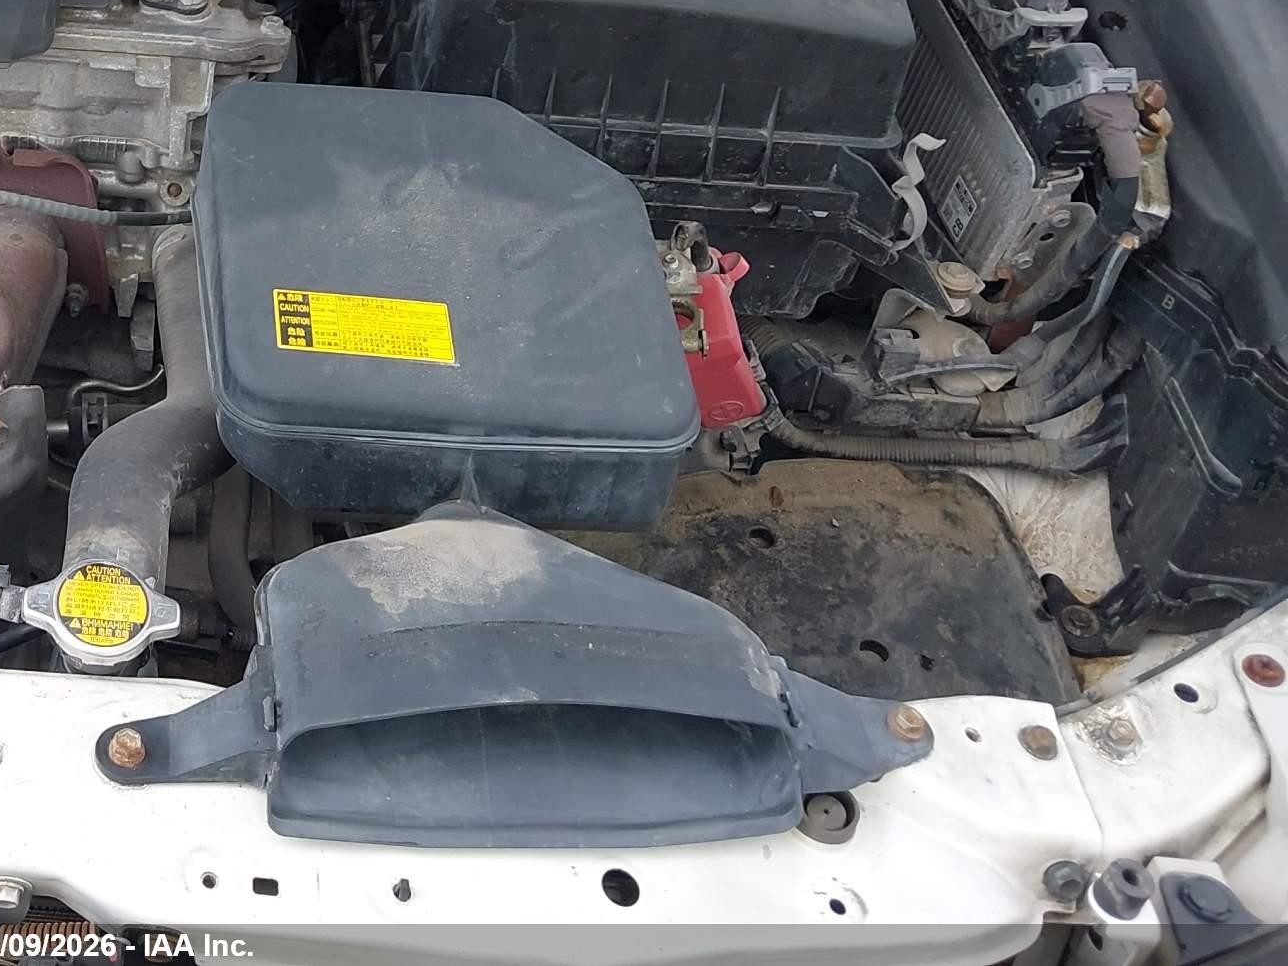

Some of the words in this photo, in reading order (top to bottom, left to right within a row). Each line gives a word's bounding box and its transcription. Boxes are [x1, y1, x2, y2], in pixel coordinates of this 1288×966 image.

[1161, 294, 1175, 310] B
[279, 303, 309, 312] CAUTION
[281, 316, 310, 325] ATTENTION
[86, 566, 121, 576] CAUTION
[85, 574, 131, 585] ATTENTION
